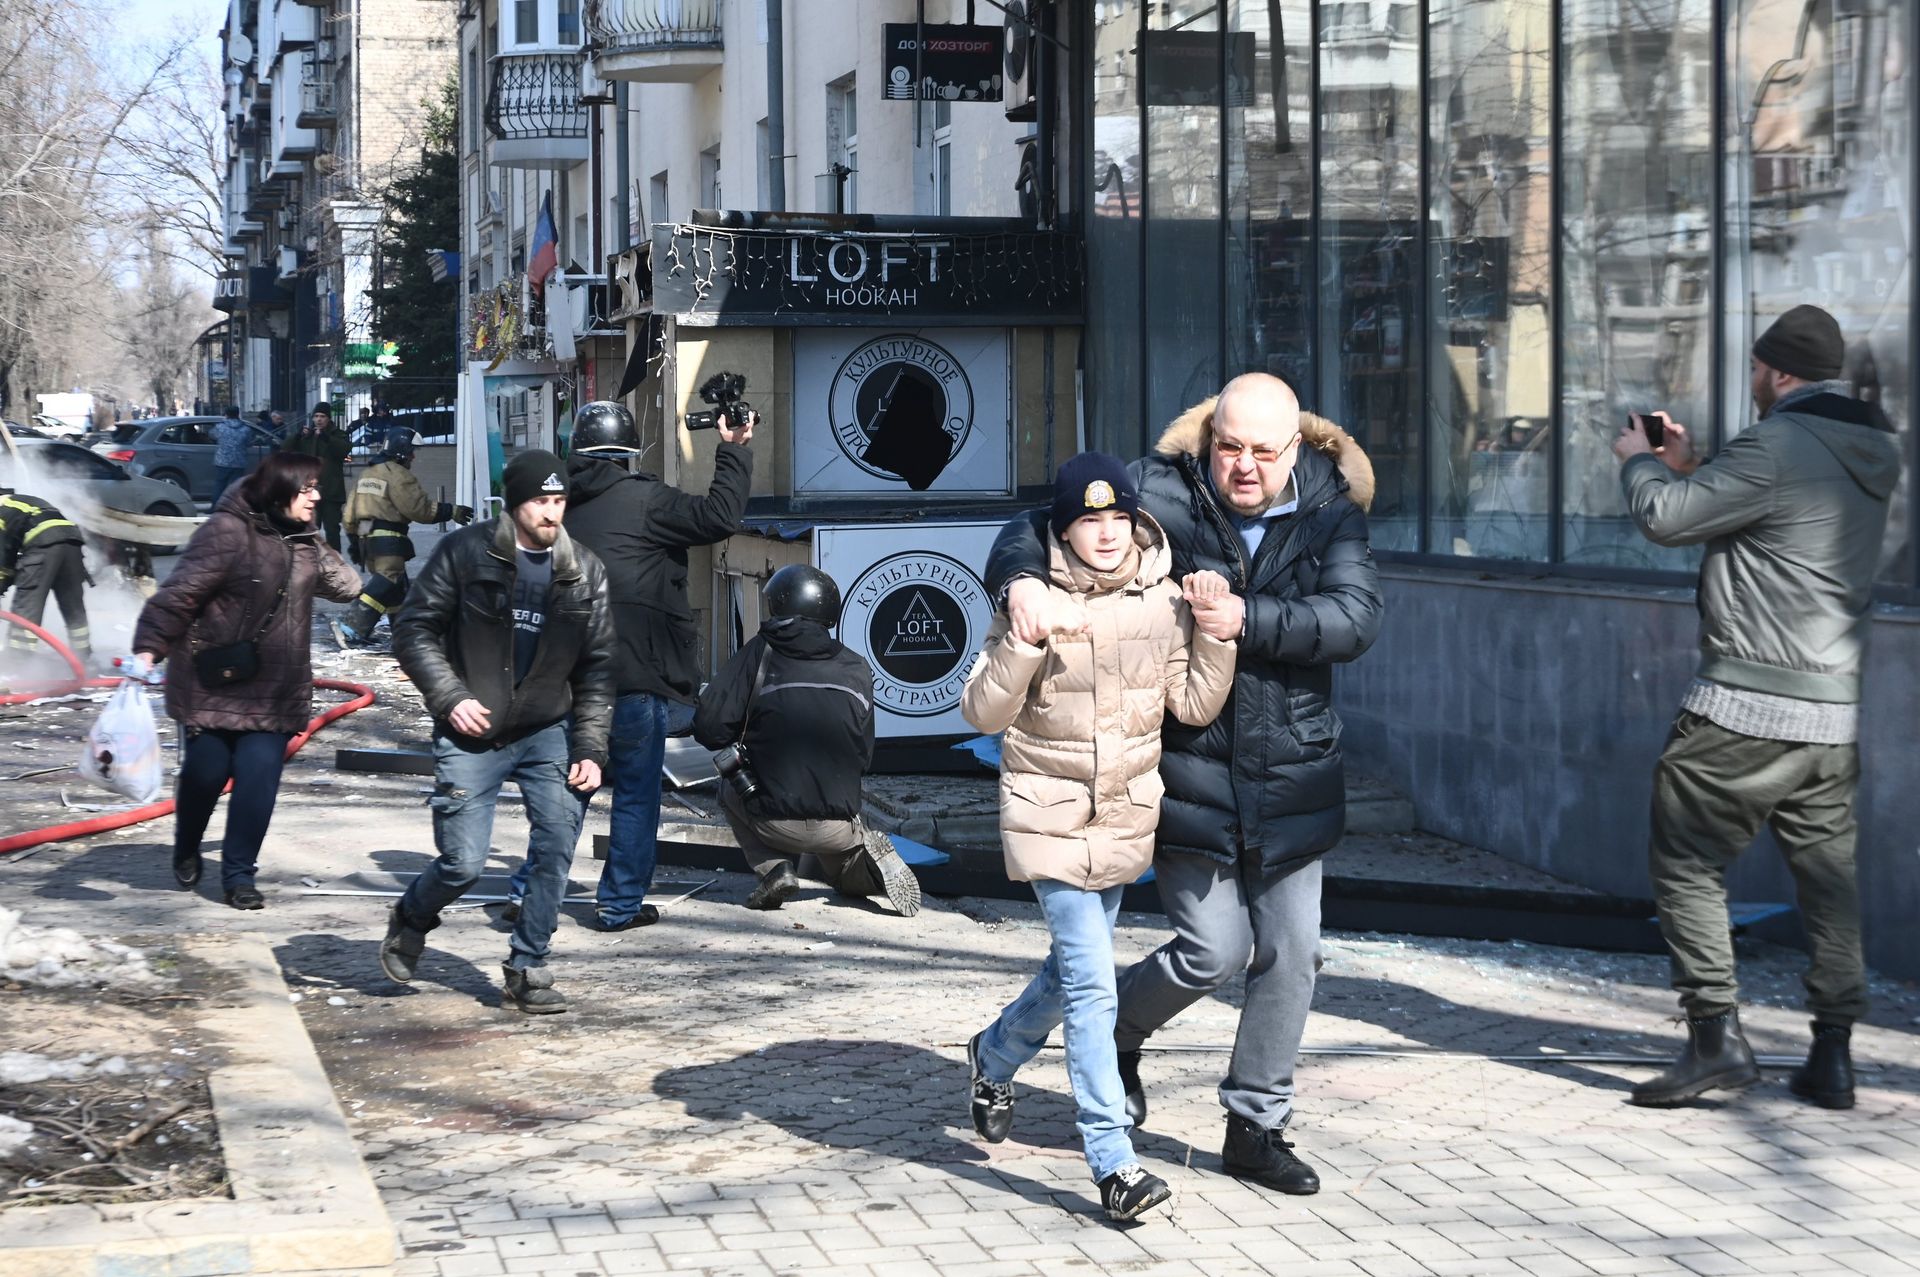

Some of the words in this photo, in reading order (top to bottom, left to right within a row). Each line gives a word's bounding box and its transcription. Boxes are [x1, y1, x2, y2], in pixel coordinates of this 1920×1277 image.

[929, 40, 990, 51] ХОЗТОРГ
[790, 238, 950, 283] LOFT
[826, 288, 917, 305] HOOKAH
[844, 340, 959, 384] КУЛЬТУРНОЕ
[857, 562, 978, 609] КУЛЬТУРНОЕ
[897, 619, 944, 635] LOFT
[902, 635, 937, 643] HOOKAH
